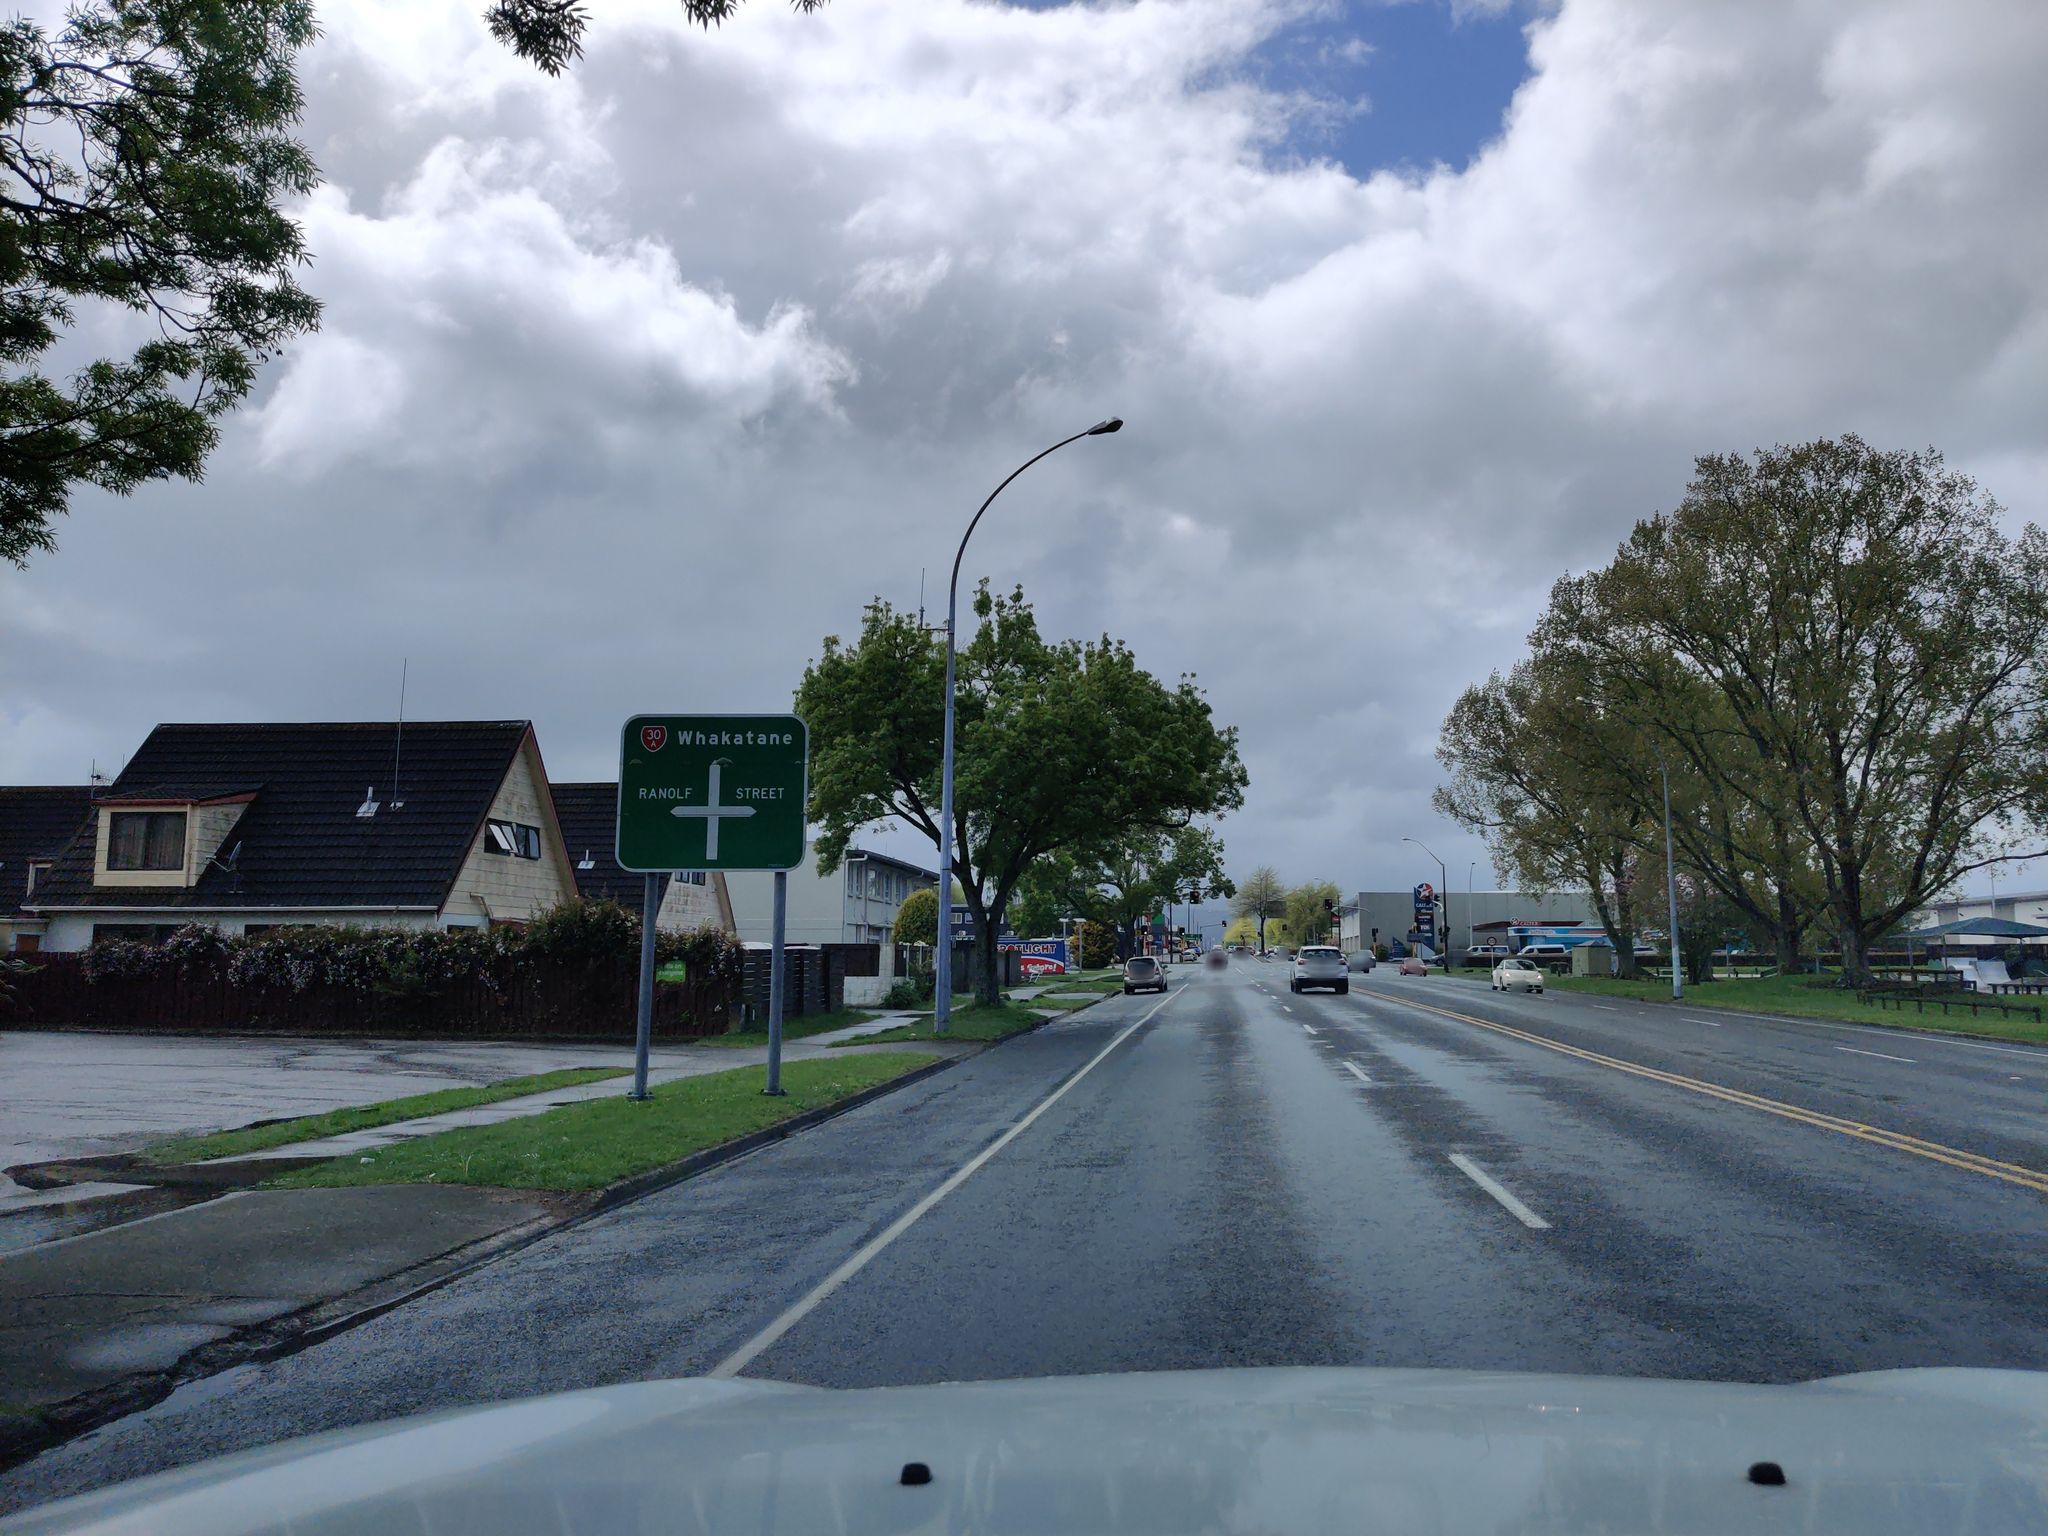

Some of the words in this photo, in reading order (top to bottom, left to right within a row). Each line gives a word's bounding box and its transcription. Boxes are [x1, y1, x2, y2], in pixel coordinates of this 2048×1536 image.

[646, 729, 661, 740] 30
[677, 730, 793, 746] Whakatane
[638, 787, 693, 800] RANOLF
[735, 787, 785, 800] STREET
